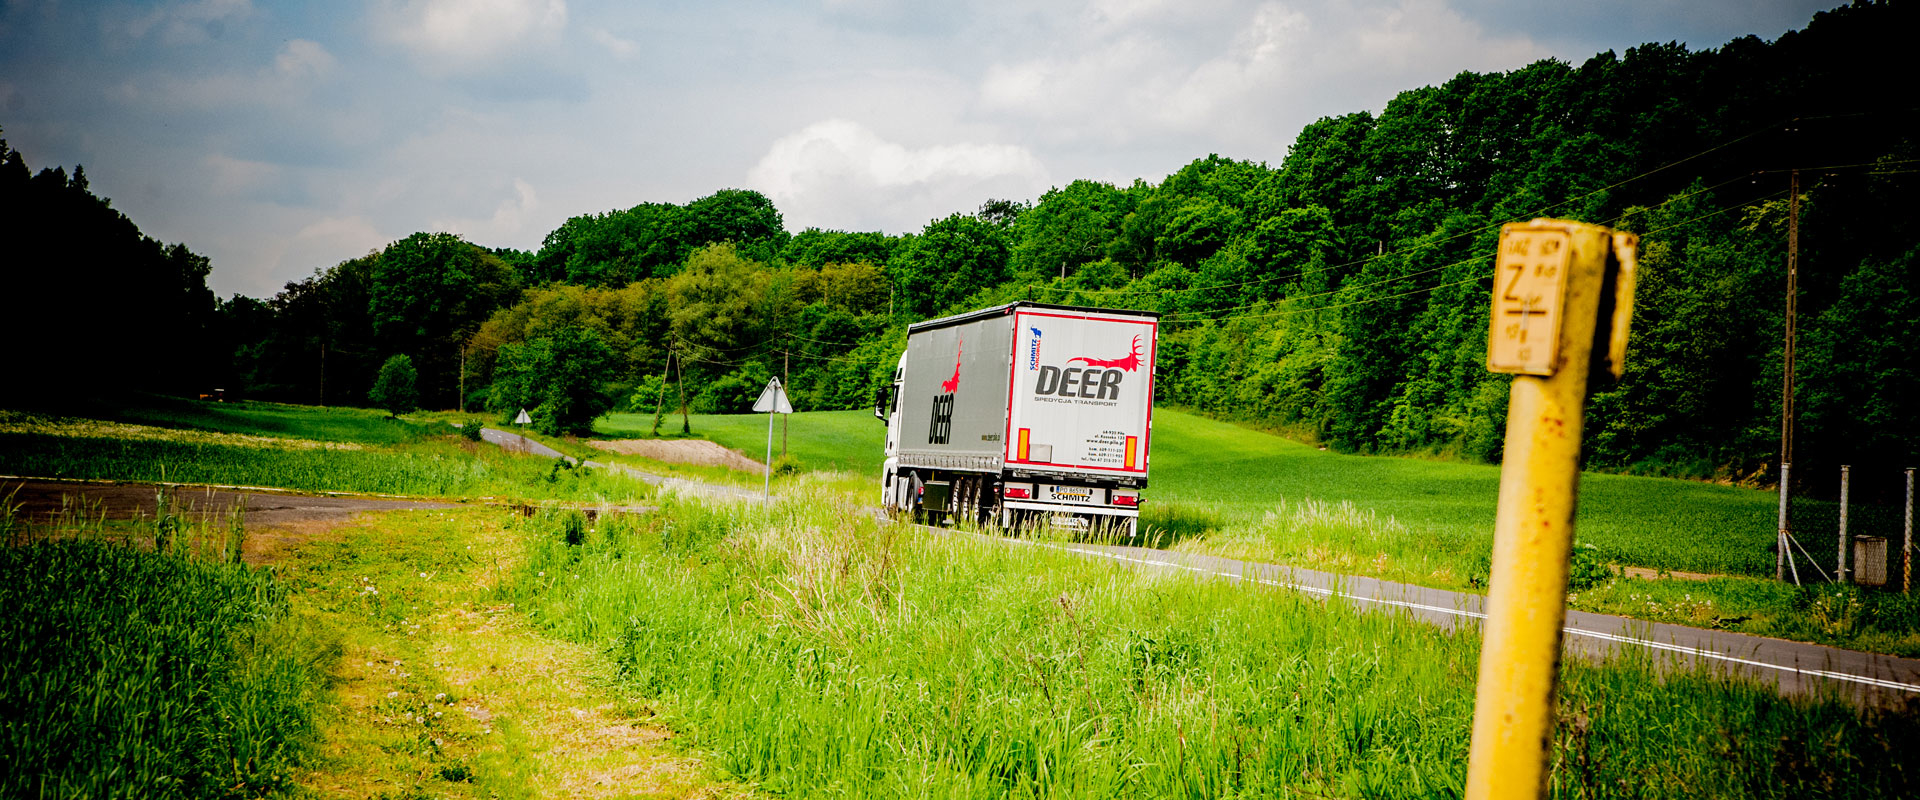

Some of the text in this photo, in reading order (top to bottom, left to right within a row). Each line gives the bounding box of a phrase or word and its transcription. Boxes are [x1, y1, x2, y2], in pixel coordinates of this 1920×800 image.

[1035, 365, 1123, 400] DEER
[1034, 396, 1118, 407] SPEDYCJA TRANSPORT
[929, 392, 954, 444] DEER
[1051, 494, 1091, 502] SCHMITZ
